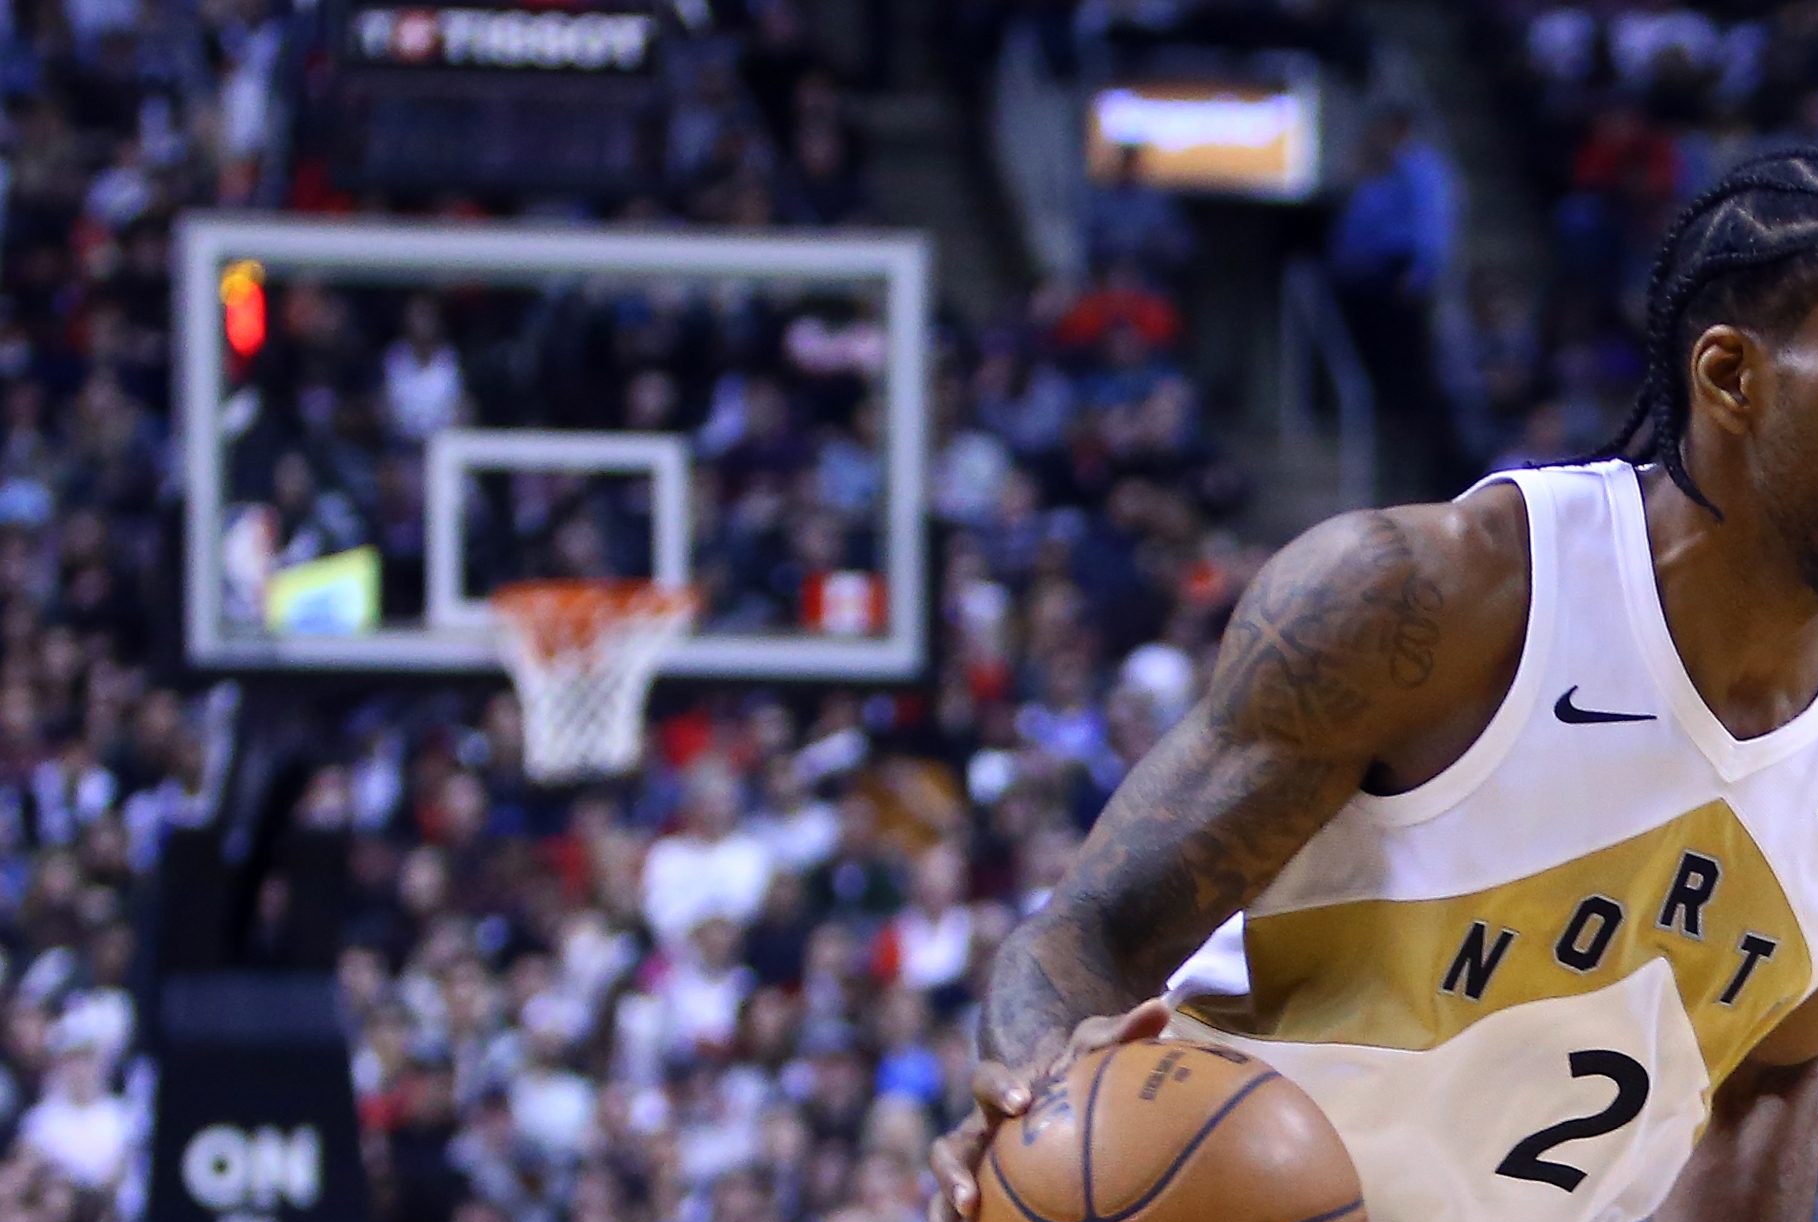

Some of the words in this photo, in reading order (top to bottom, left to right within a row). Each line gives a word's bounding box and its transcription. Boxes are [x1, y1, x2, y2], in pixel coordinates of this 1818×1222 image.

[1438, 848, 1790, 1018] NORT
[182, 1124, 322, 1210] ON
[1495, 1049, 1649, 1192] 2
